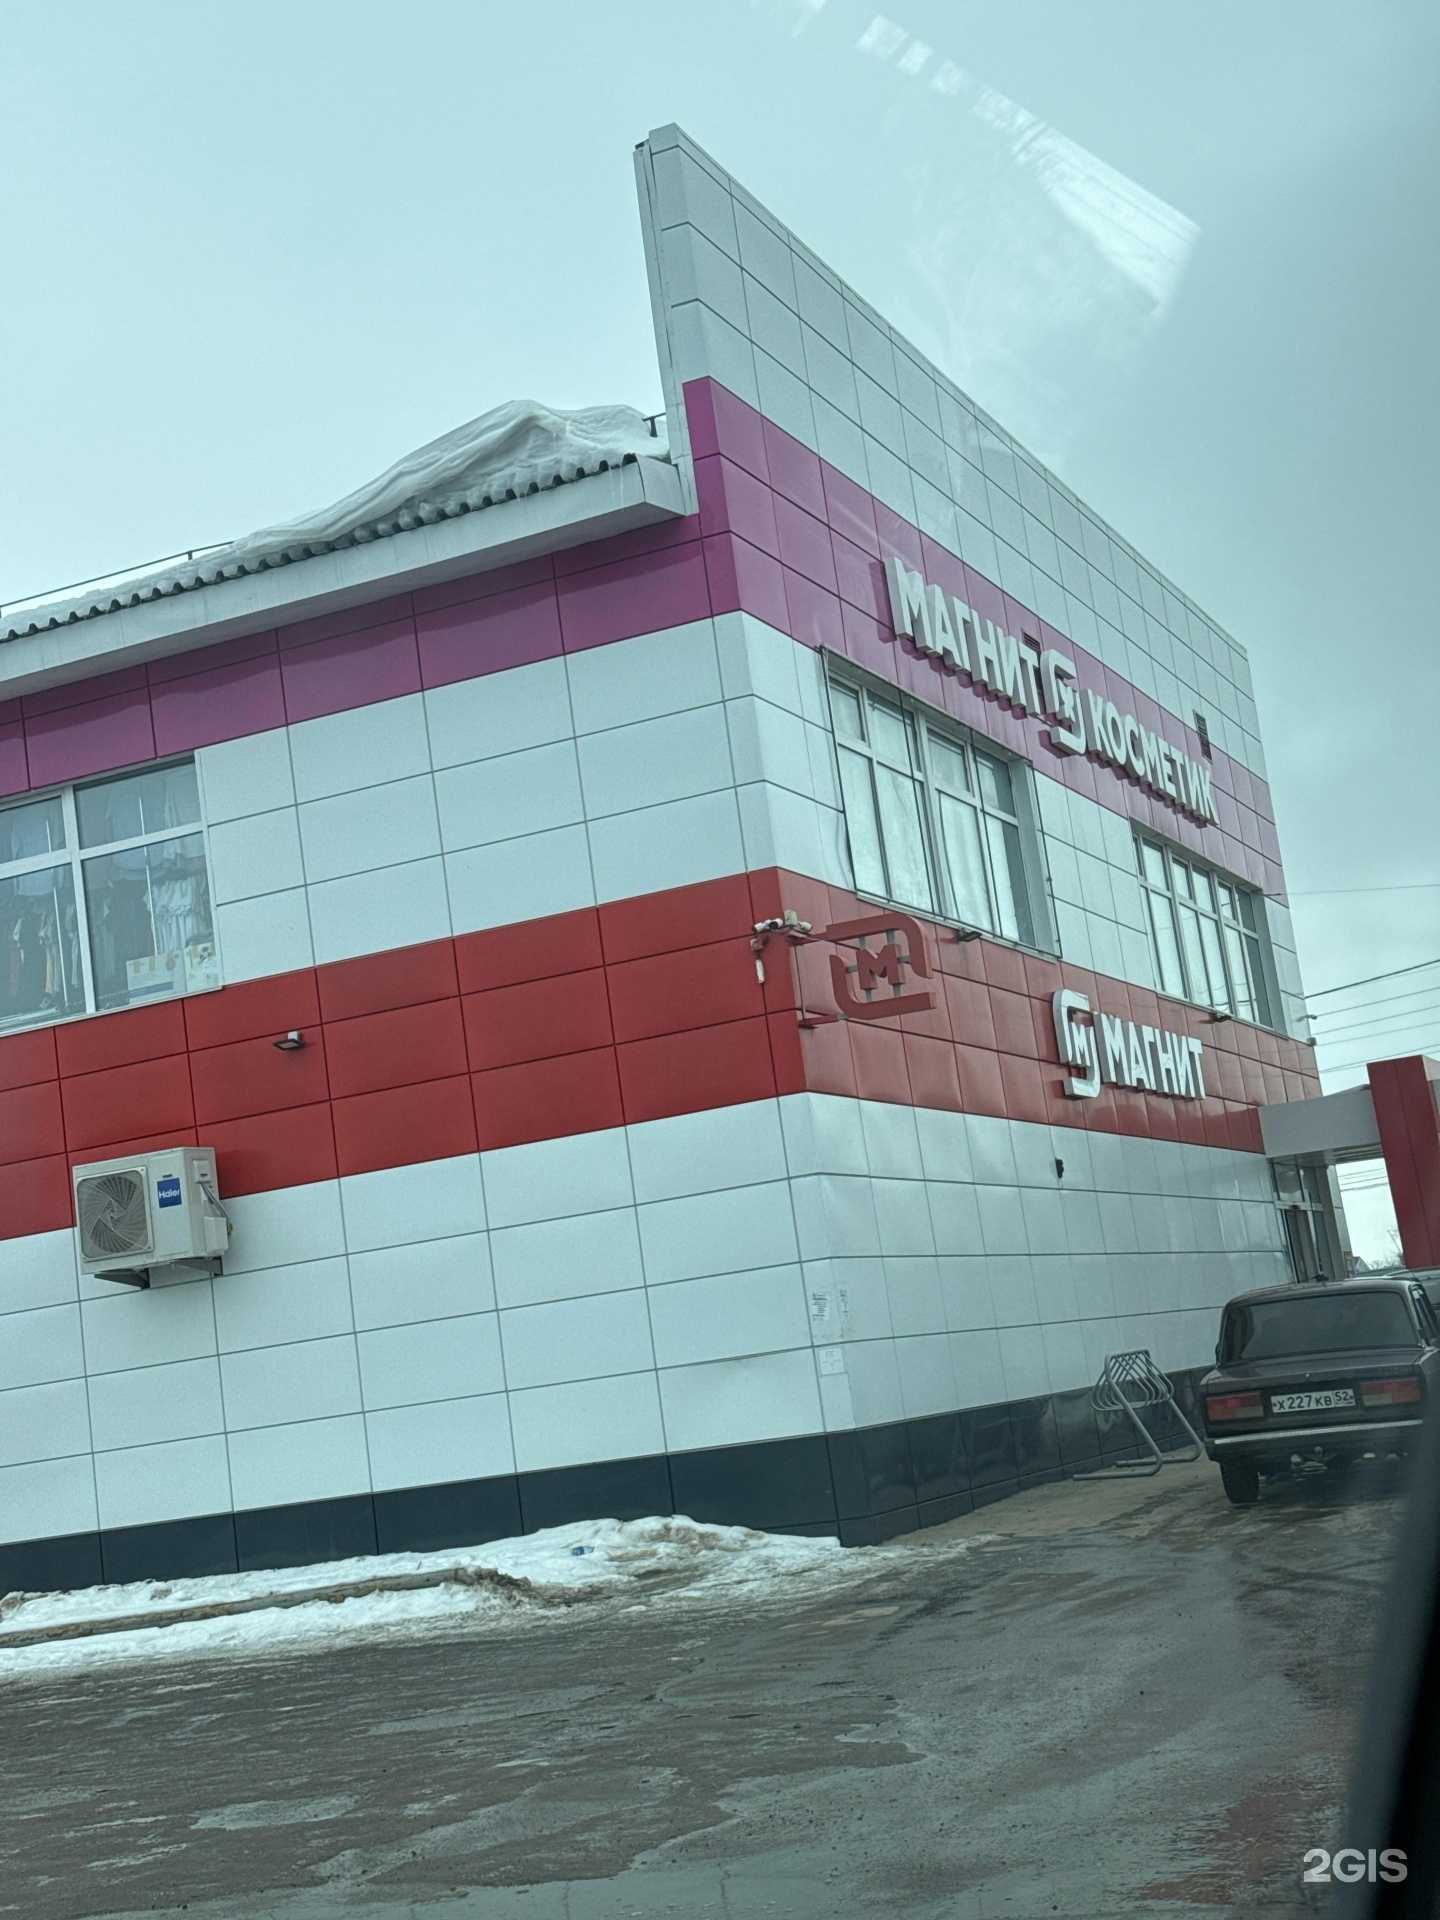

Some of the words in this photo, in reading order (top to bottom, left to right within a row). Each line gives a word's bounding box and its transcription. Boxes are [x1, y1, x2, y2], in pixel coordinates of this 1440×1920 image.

[888, 557, 1041, 719] МАГНИТ
[1085, 688, 1219, 826] КОСМЕТИК
[1100, 1012, 1206, 1099] МАГНИТ
[158, 1188, 180, 1199] Haier
